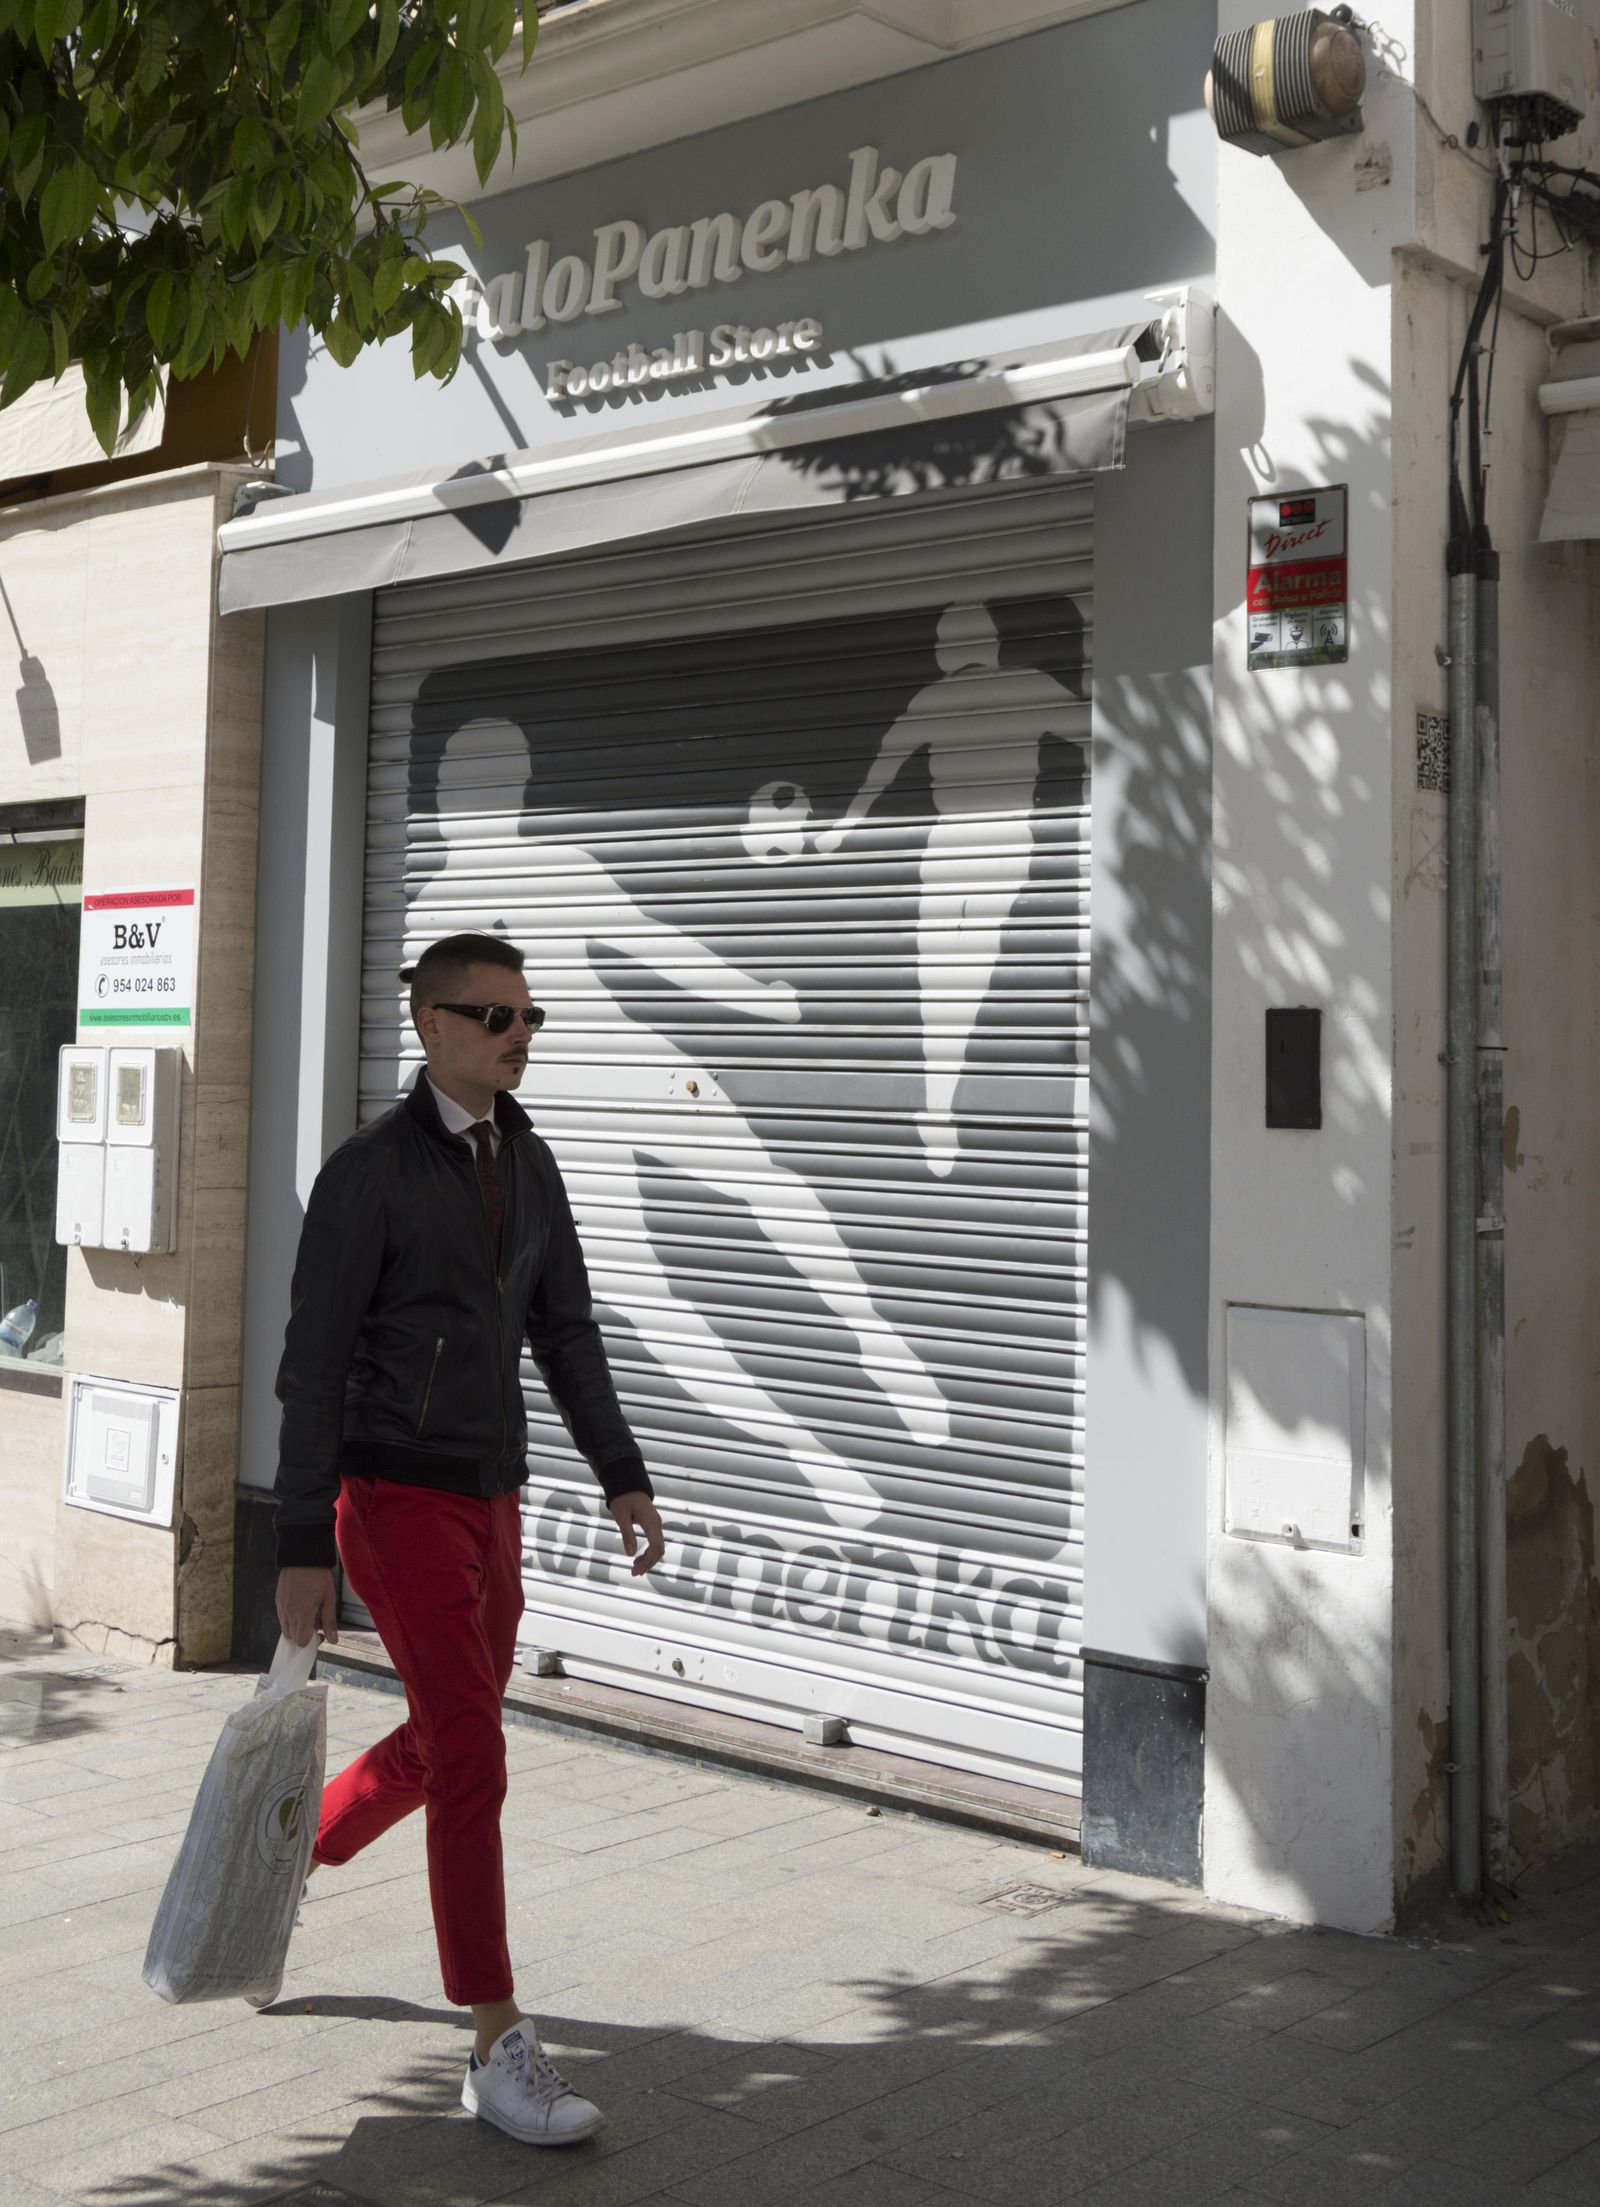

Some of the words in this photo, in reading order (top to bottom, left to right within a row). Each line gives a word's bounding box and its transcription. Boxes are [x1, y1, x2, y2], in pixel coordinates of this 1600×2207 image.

[544, 330, 705, 402] Football
[709, 316, 824, 368] Store
[1265, 518, 1335, 559] Direct
[1252, 570, 1342, 595] Alarma
[1252, 598, 1270, 607] con
[113, 978, 132, 993] 954
[134, 978, 154, 992] 024
[156, 977, 176, 992] 863
[521, 1488, 1071, 1681] oPanenka
